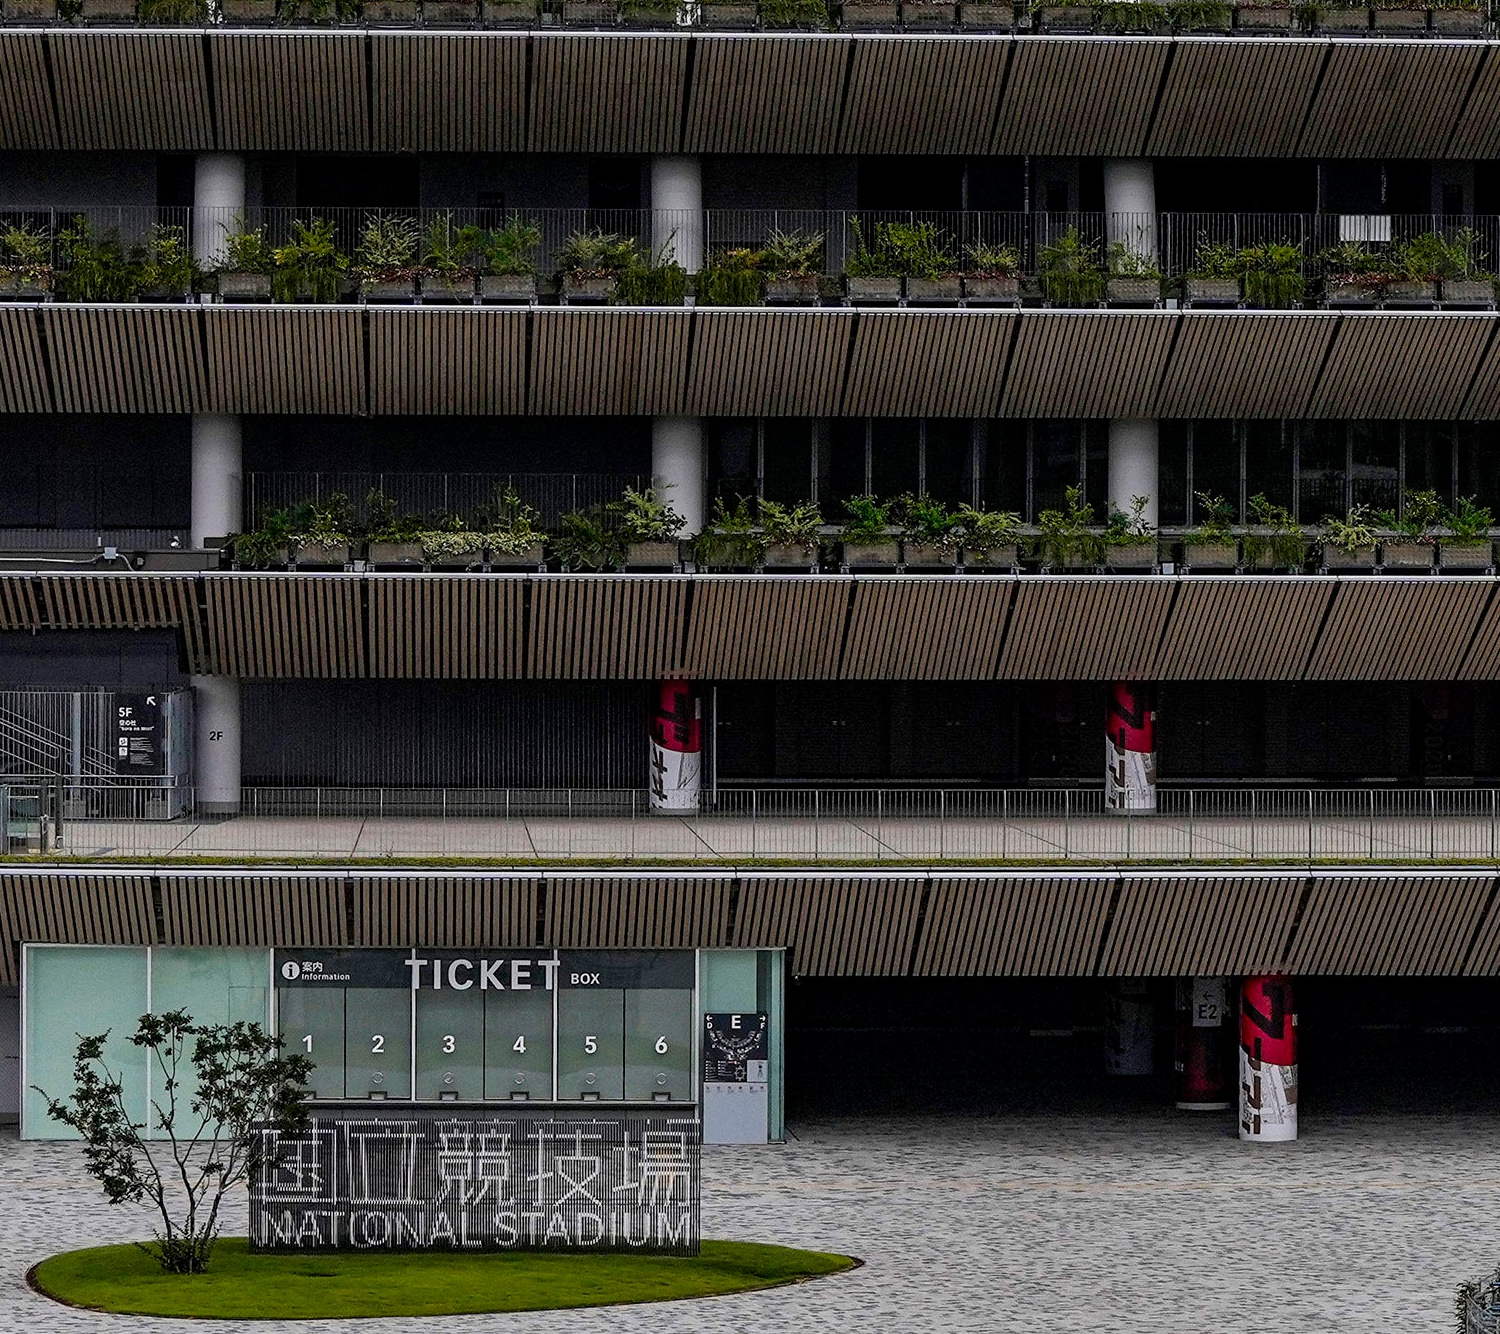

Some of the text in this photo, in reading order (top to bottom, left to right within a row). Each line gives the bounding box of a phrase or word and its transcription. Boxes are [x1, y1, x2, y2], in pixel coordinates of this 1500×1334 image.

[118, 707, 133, 717] 5F
[209, 730, 223, 741] 2F
[302, 961, 323, 972] 案内
[404, 959, 601, 990] TICKET BOX
[301, 973, 351, 981] Information
[1198, 1004, 1218, 1020] E2
[731, 1015, 742, 1029] E
[302, 1034, 313, 1053] 1
[371, 1034, 385, 1053] 2
[442, 1034, 456, 1054] 3
[512, 1035, 527, 1054] 4
[584, 1035, 598, 1054] 5
[654, 1035, 669, 1055] 6
[262, 1126, 691, 1207] 国立競技場
[260, 1210, 690, 1248] NATIONAL STADIUM
